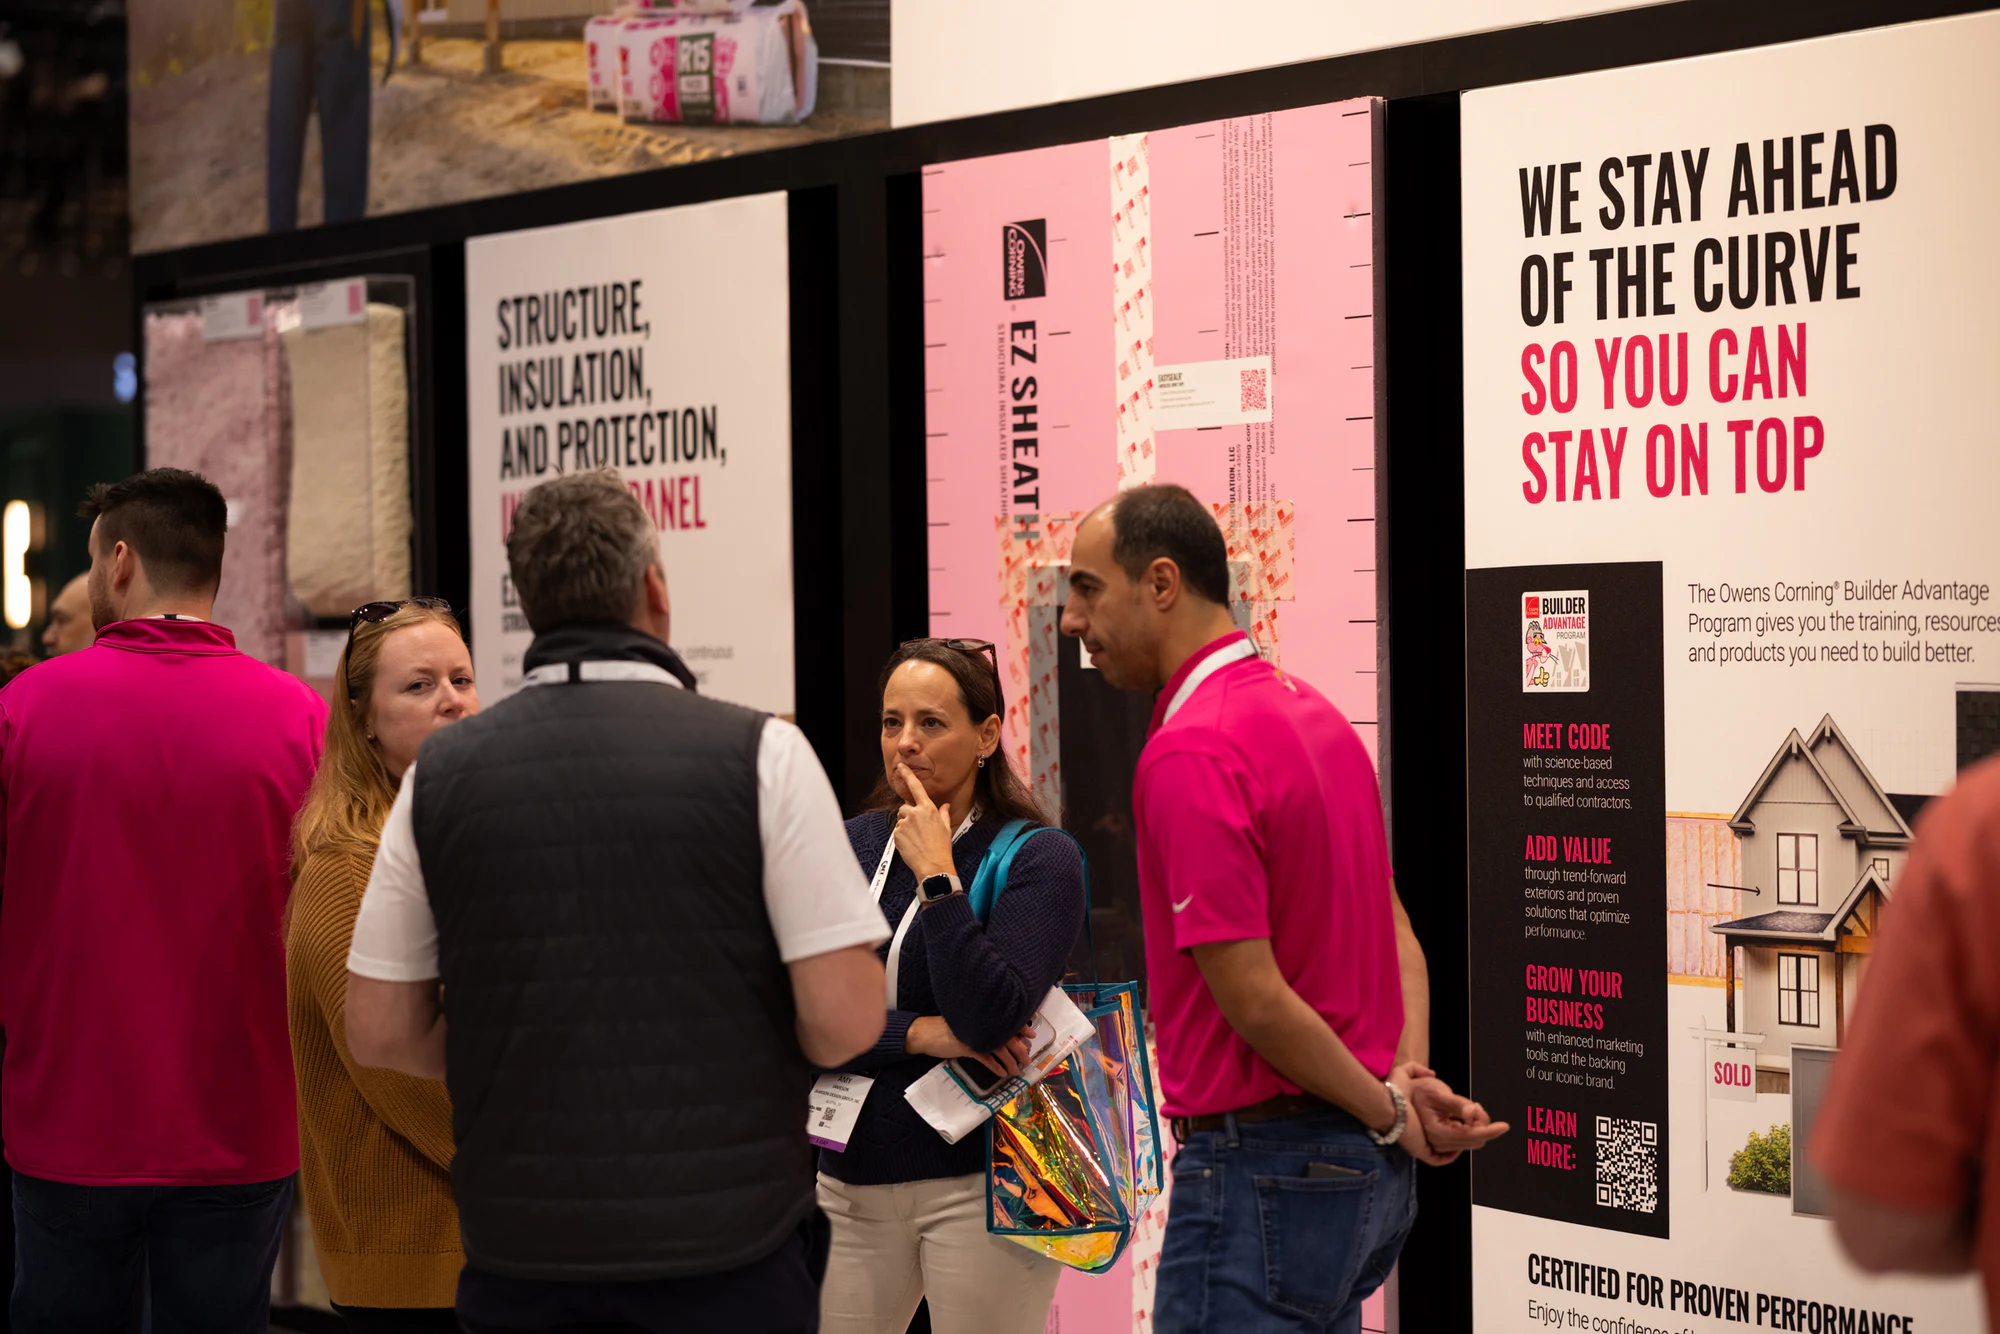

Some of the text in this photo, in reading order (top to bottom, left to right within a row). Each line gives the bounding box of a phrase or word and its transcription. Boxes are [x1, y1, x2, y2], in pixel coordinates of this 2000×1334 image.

[1519, 123, 1897, 238] WE STAY AHEAD
[1008, 228, 1018, 298] CORNING
[1017, 238, 1026, 296] OWENS
[1520, 223, 1860, 326] OF THE CURVE
[498, 280, 650, 350] STRUCTURE,
[998, 324, 1006, 394] STRUCTURAL
[1521, 322, 1806, 416] SO YOU CAN
[499, 347, 652, 416] INSULATION,
[501, 404, 726, 482] AND PROTECTION,
[1011, 320, 1040, 540] EZ SHEATH
[1522, 416, 1824, 504] STAY ON TOP
[1237, 470, 1241, 481] OH
[1000, 464, 1009, 528] SHEATHING
[1542, 597, 1586, 614] BUILDER
[1688, 579, 1990, 606] The Owens Corning® Builder Advantage
[1543, 616, 1586, 630] ADVANTAGE
[1556, 632, 1586, 640] PROGRAM
[1688, 612, 1752, 637] Program
[1756, 612, 1794, 637] gives
[1798, 616, 1826, 637] you
[1830, 611, 1854, 632] the
[1858, 611, 1920, 636] training,
[1688, 640, 1975, 667] and products you need to build better.
[1524, 724, 1610, 750] MEET CODE
[1523, 755, 1612, 770] with science-based
[1524, 774, 1630, 790] techniques and access
[1524, 793, 1632, 810] to qualified contractors.
[1525, 835, 1612, 864] ADD VALUE
[1525, 866, 1626, 884] through trend-forward
[1525, 886, 1619, 905] exteriors and proven
[1525, 904, 1630, 924] solutions that optimize
[1526, 924, 1586, 940] performance.
[1526, 964, 1622, 998] GROW YOUR
[1526, 996, 1604, 1030] BUSINESS
[1526, 1029, 1644, 1058] with enhanced marketing
[1526, 1047, 1626, 1075] tools and the backing
[1714, 1061, 1751, 1087] SOLD
[838, 1076, 852, 1084] AMY
[1526, 1066, 1616, 1090] of our iconic brand.
[1528, 1106, 1576, 1138] LEARN
[1528, 1138, 1576, 1170] MORE:
[1528, 1253, 1914, 1334] CERTIFIED FOR PROVEN PERFORMANCE
[1528, 1300, 1669, 1334] Enjoy the confiden
